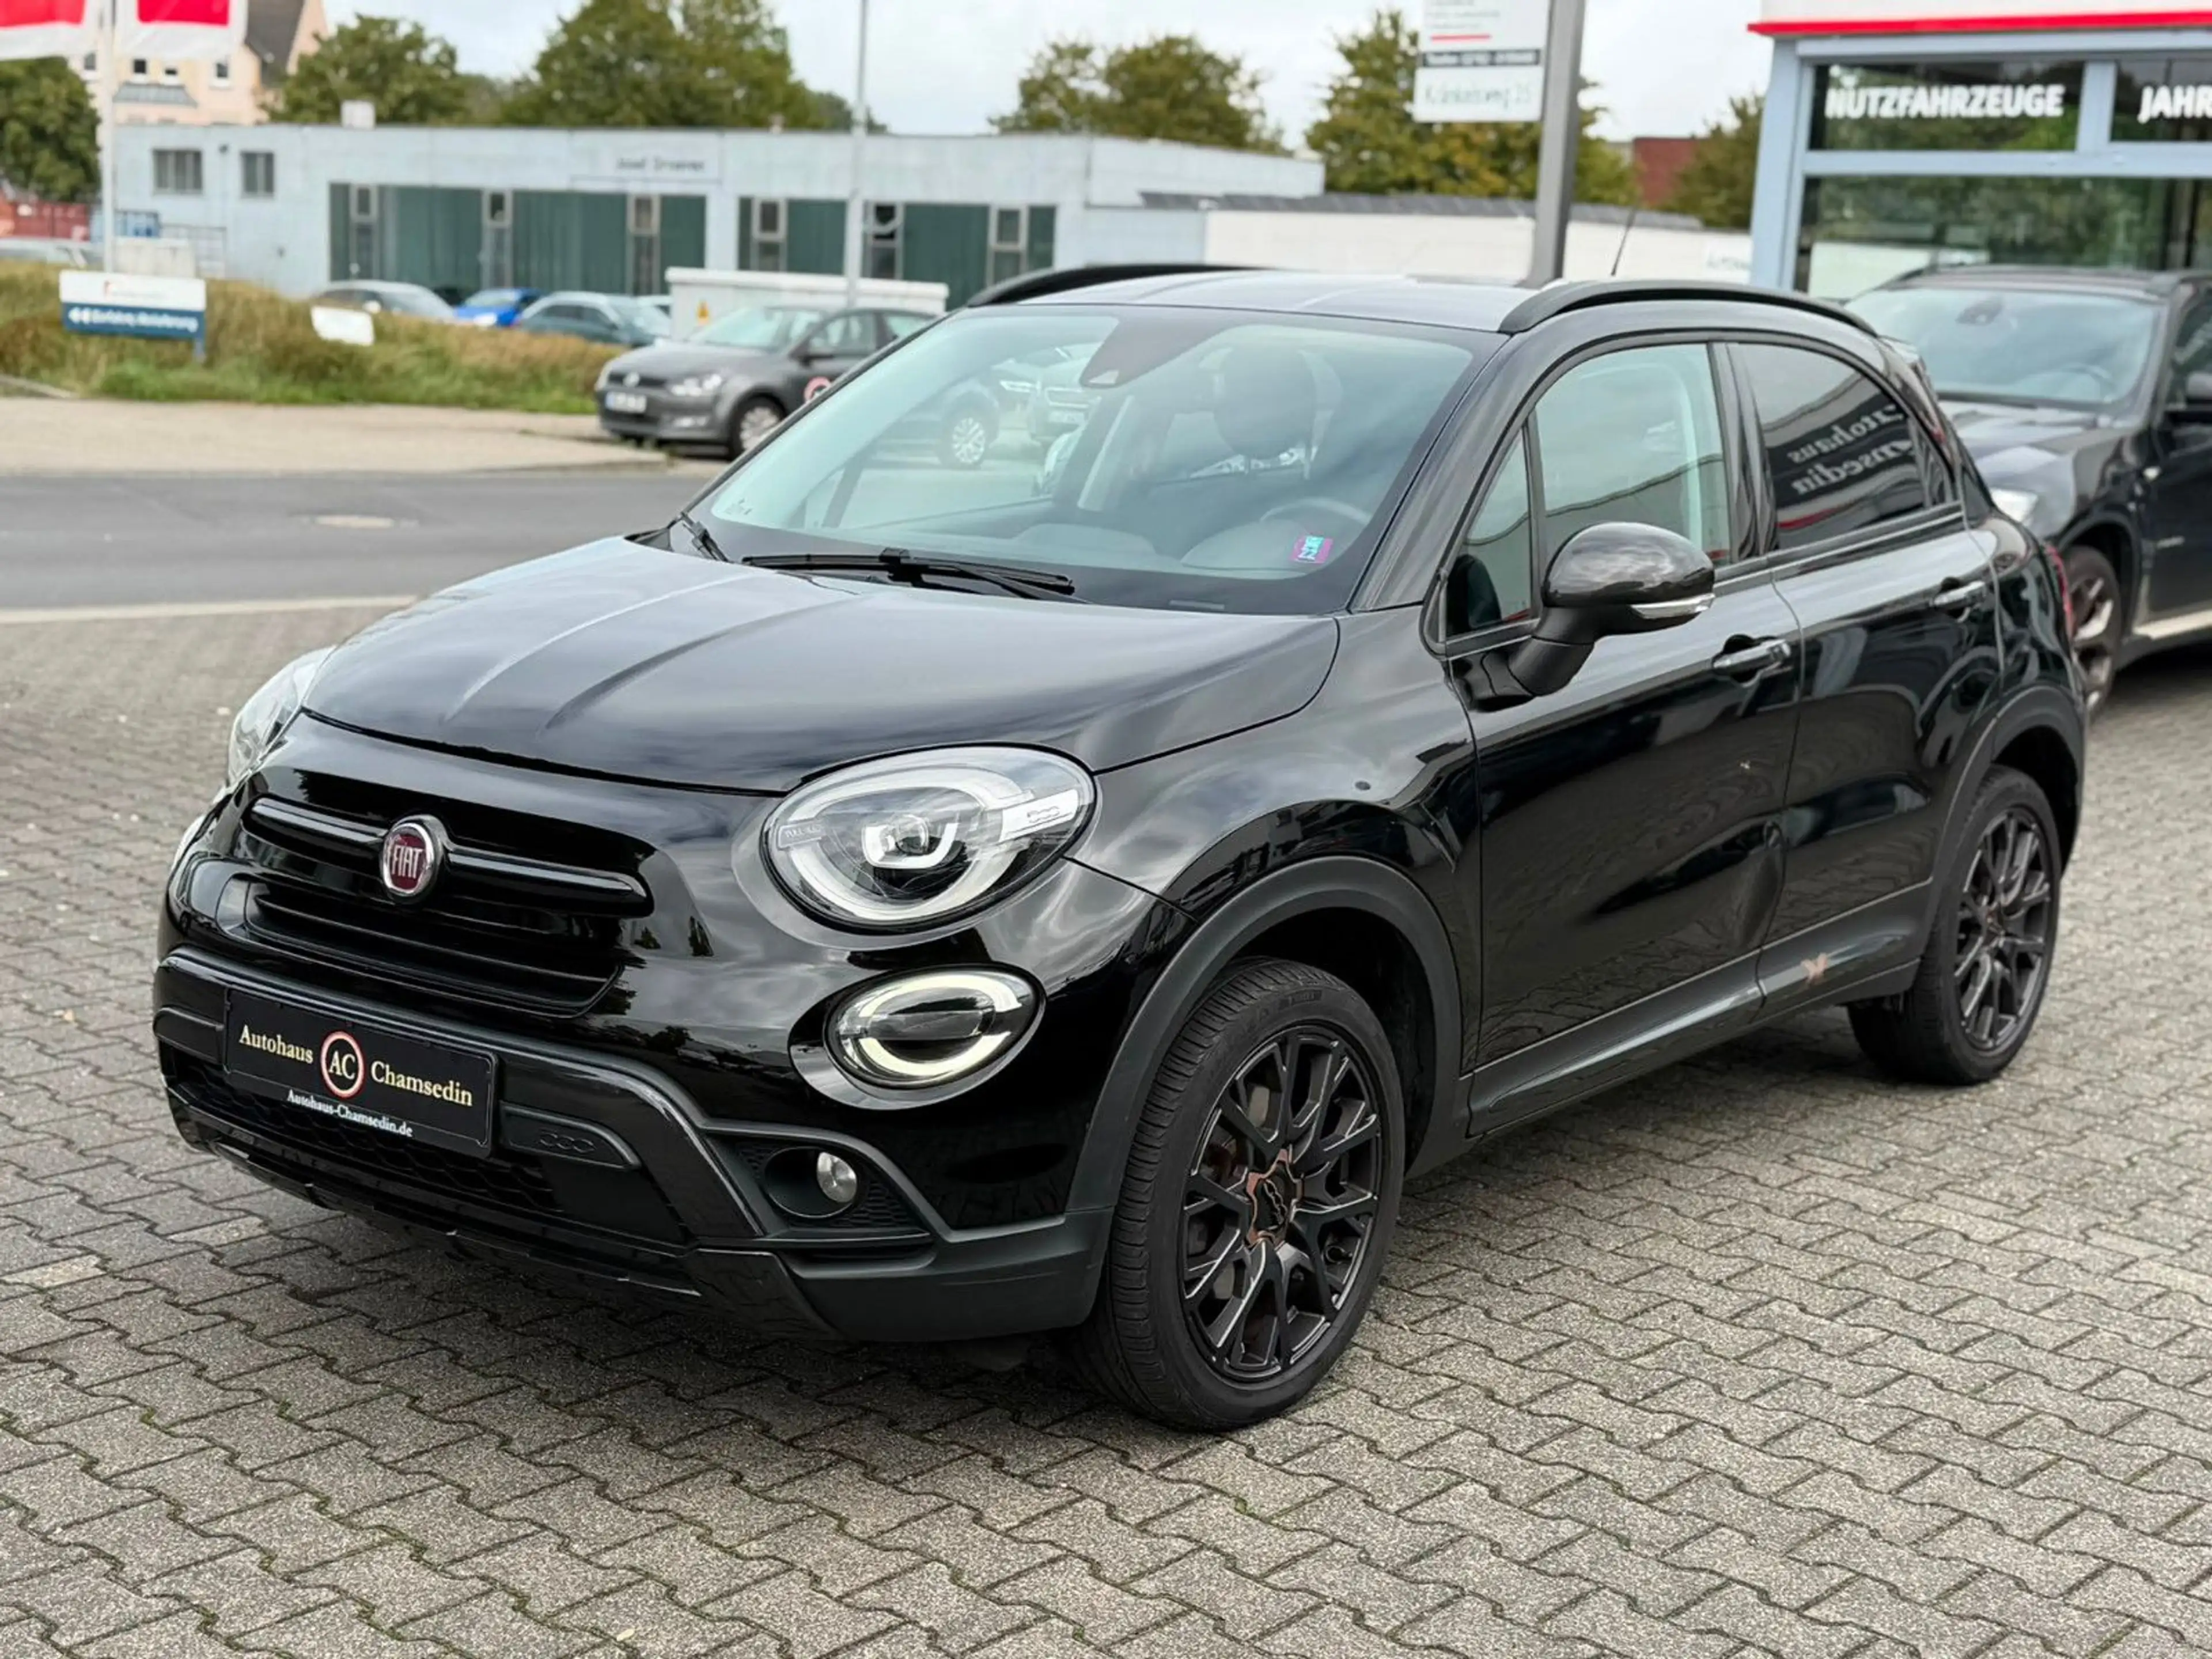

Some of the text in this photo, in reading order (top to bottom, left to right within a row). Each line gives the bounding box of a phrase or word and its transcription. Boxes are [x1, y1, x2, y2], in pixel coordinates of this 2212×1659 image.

[1825, 84, 2066, 119] NUTZFAHRZEUGE
[391, 844, 423, 879] FIAT
[239, 1024, 474, 1107] Autohaus AC Chamsedin
[287, 1089, 414, 1138] Autohaus-Chamsedin.de
